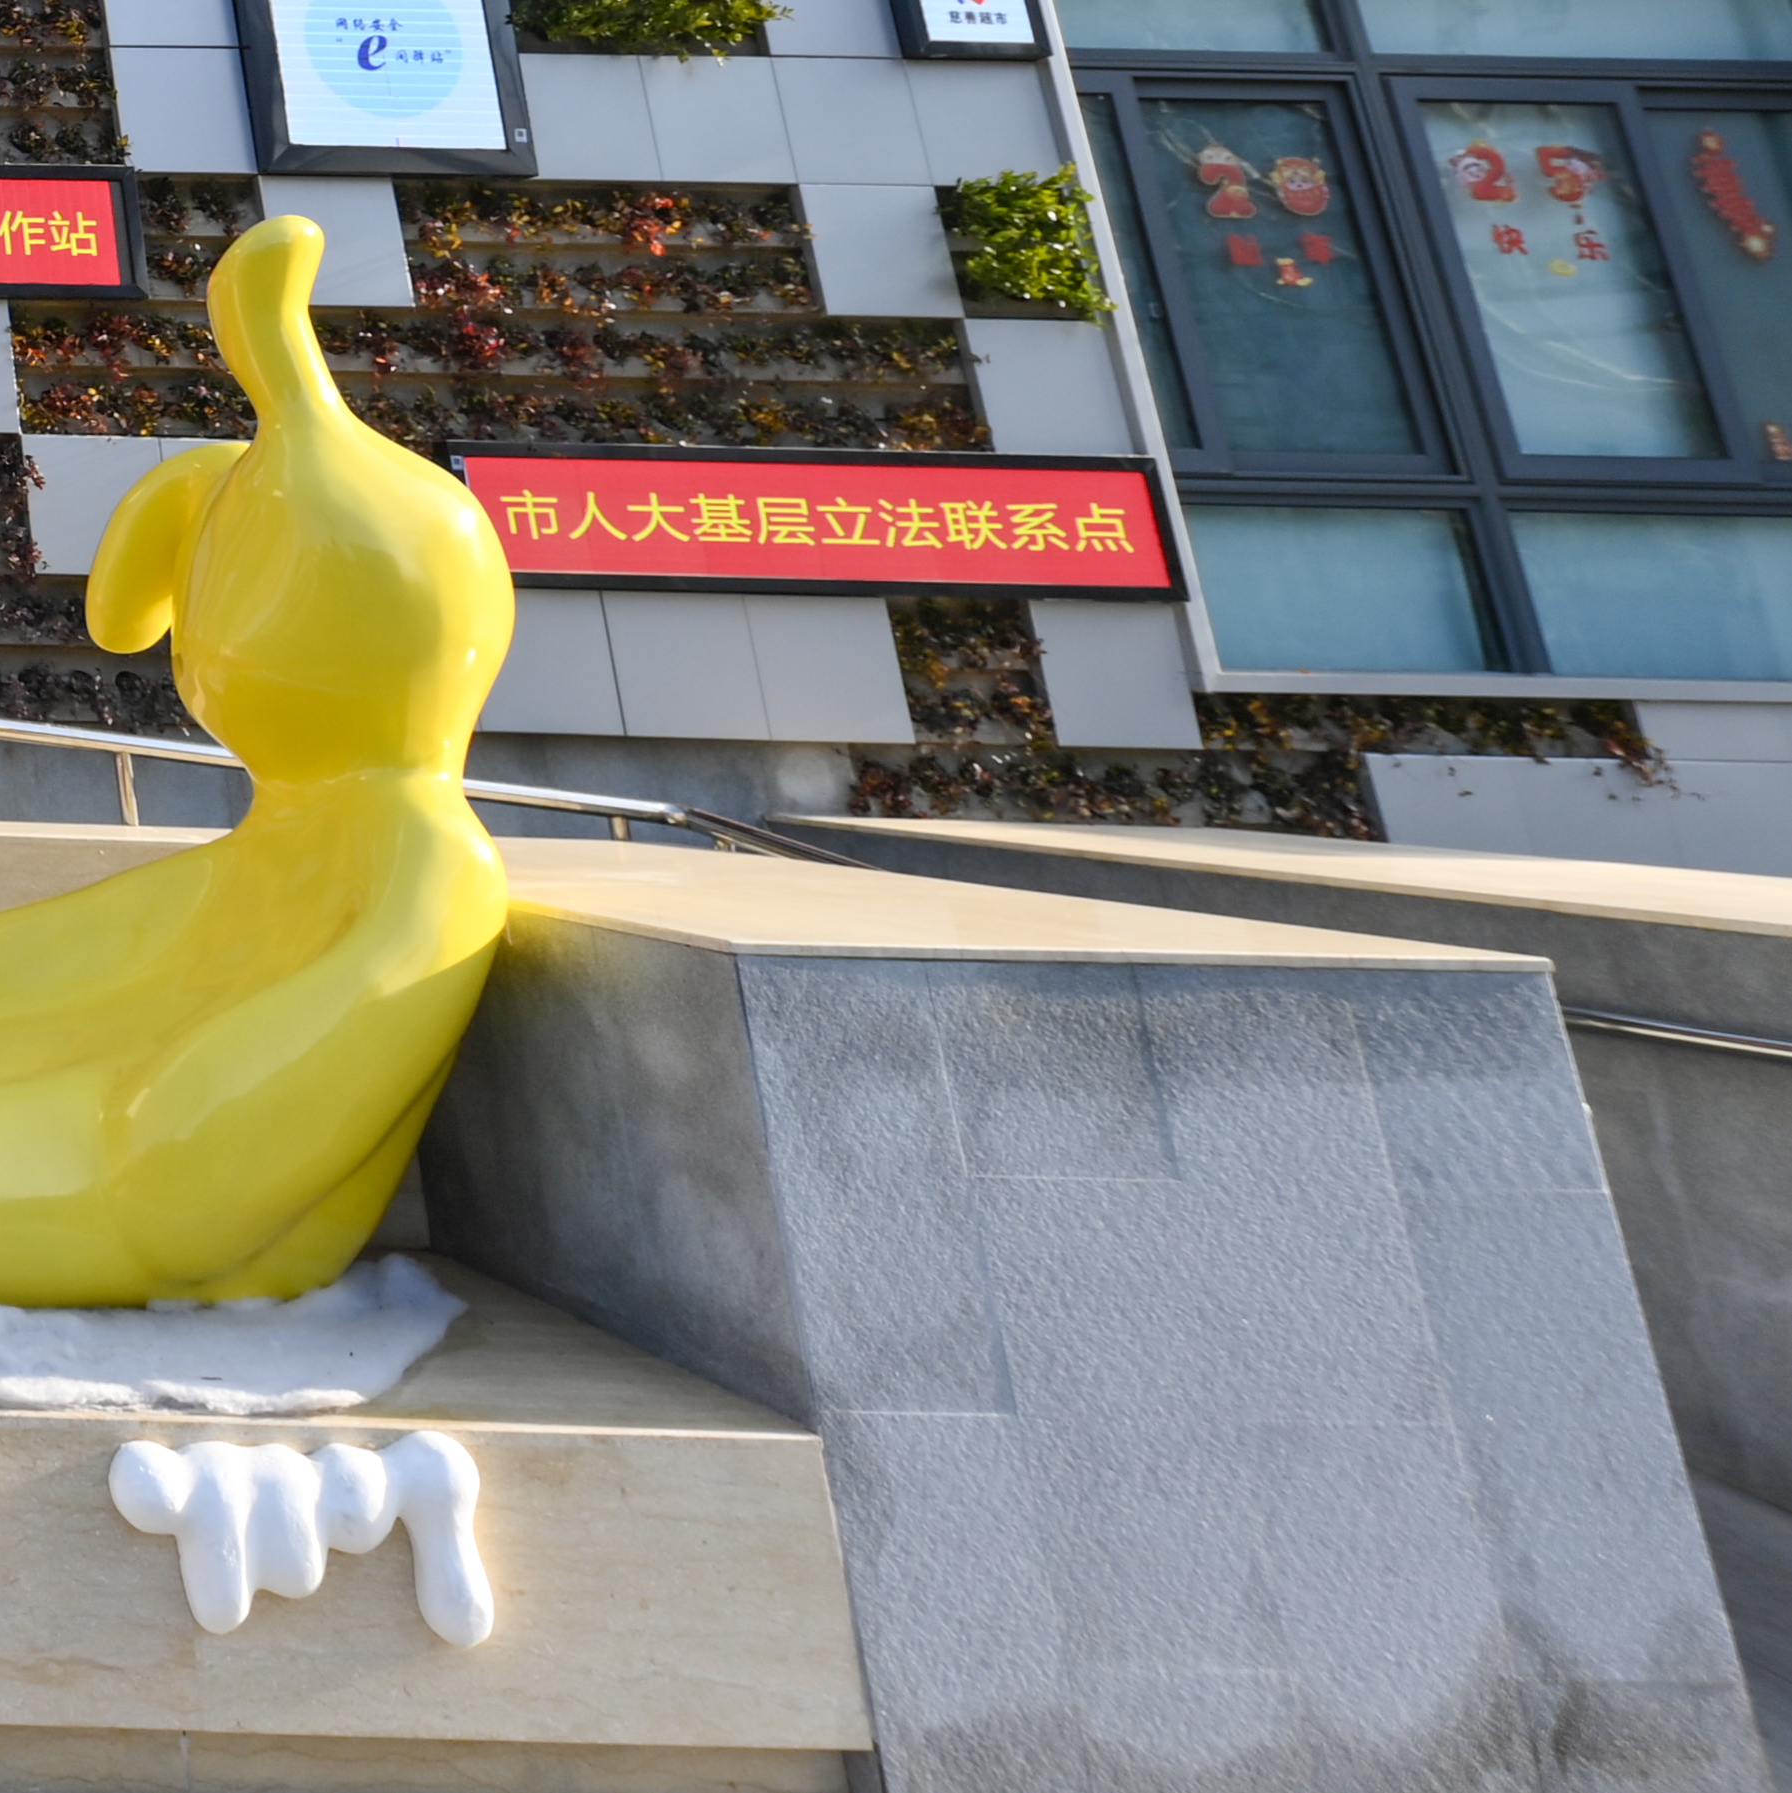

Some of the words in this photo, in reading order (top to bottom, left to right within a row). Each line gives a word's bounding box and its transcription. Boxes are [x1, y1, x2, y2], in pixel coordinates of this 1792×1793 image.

[500, 489, 1135, 554] 市人大基层立法联系点
